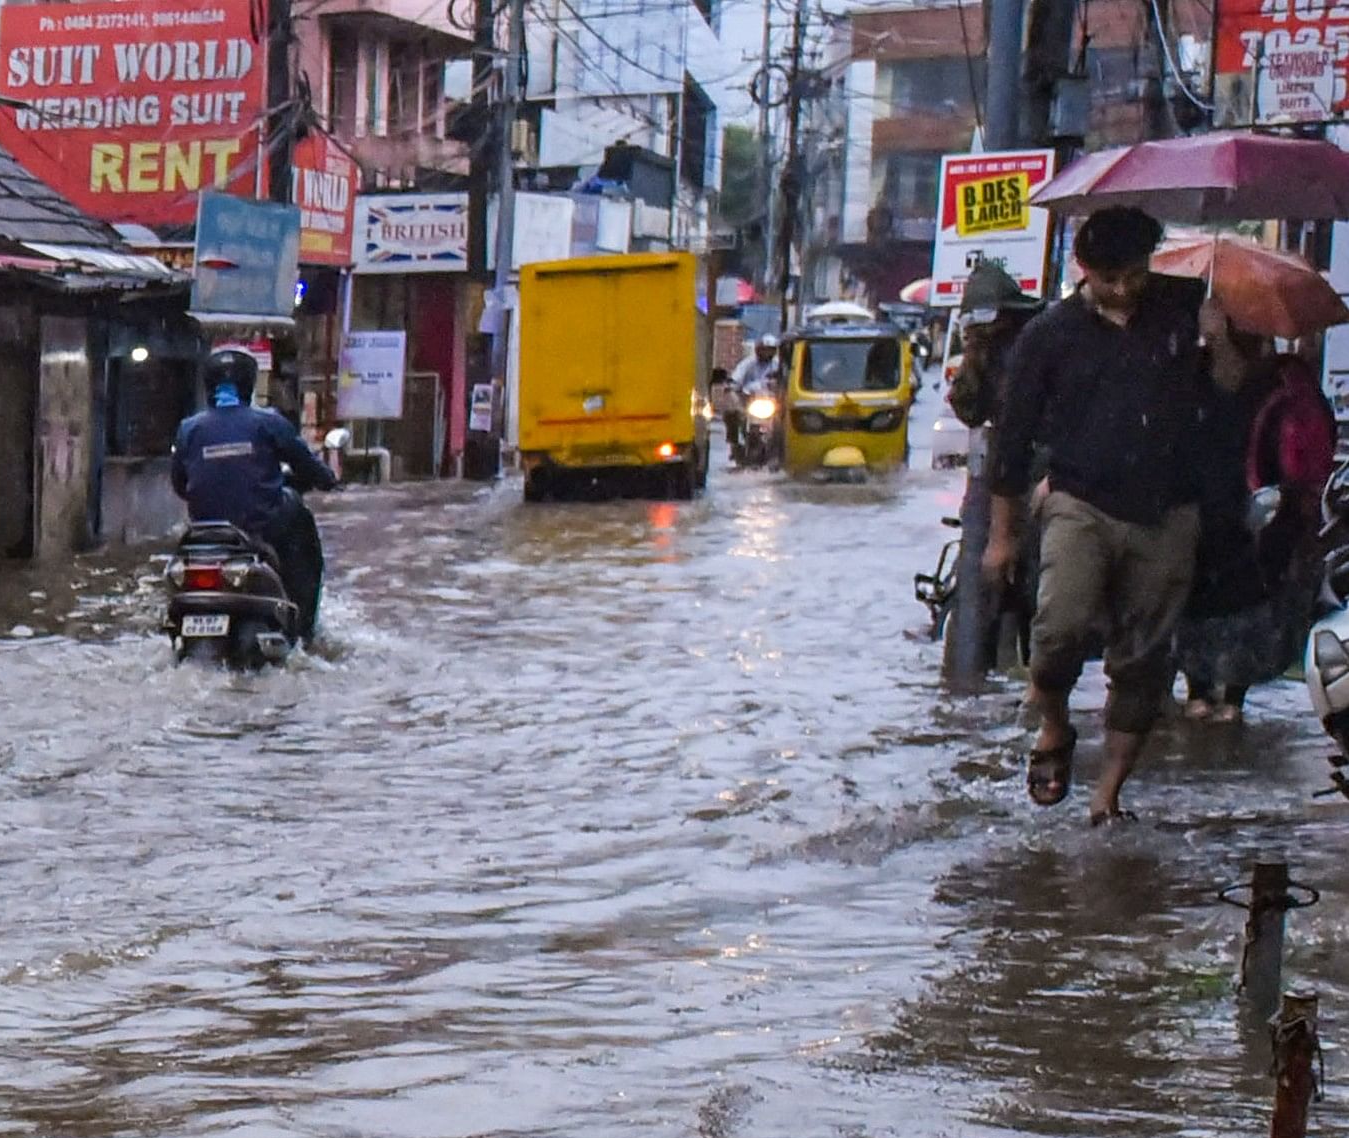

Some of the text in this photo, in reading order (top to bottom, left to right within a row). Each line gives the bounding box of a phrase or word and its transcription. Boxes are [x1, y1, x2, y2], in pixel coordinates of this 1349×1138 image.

[7, 38, 252, 87] SUIT WORLD
[16, 91, 246, 131] WEDDING SUIT
[89, 138, 240, 193] RENT
[964, 176, 1020, 208] B.DES
[381, 223, 464, 240] BRITISH
